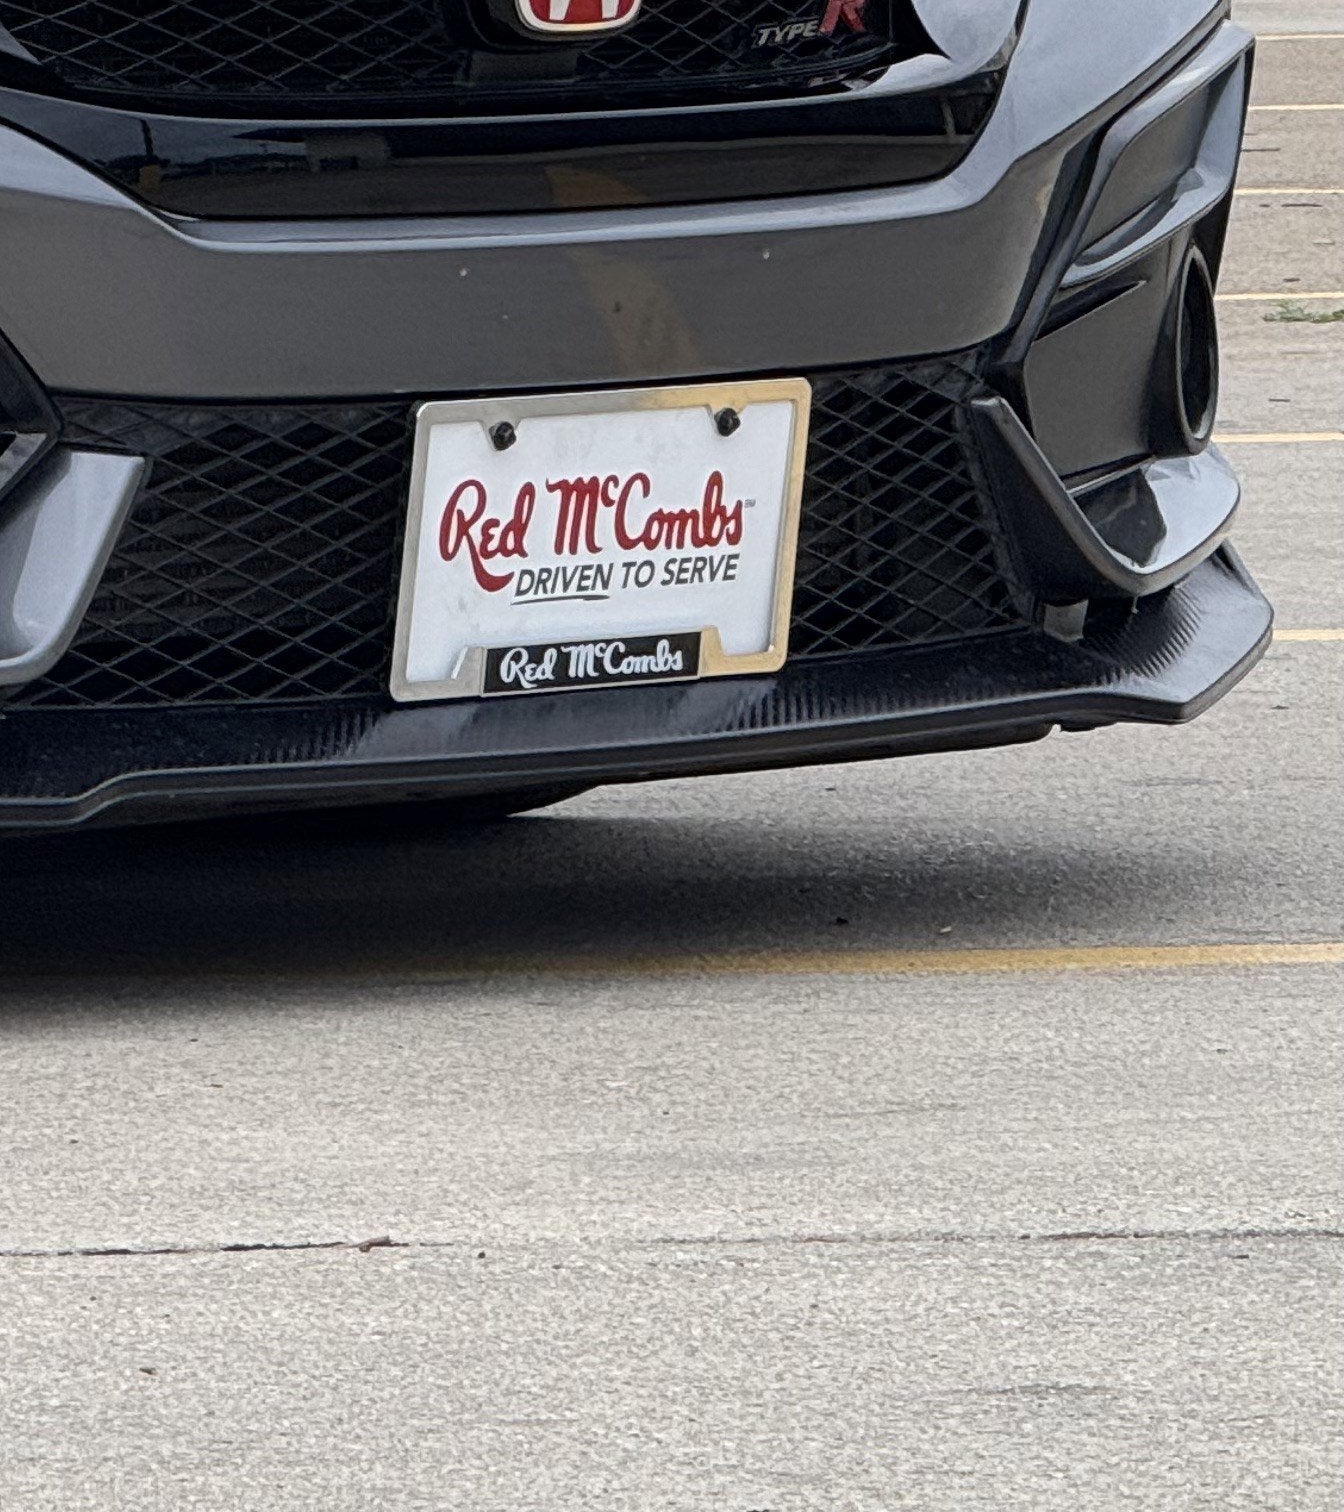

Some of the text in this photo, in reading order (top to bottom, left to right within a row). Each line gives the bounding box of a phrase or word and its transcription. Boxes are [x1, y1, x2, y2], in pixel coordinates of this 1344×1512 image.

[757, 18, 820, 46] TYPE
[439, 471, 743, 592] Red McCombs
[515, 553, 740, 597] DRIVEN TO SERVE
[500, 638, 684, 688] Red McCombs
